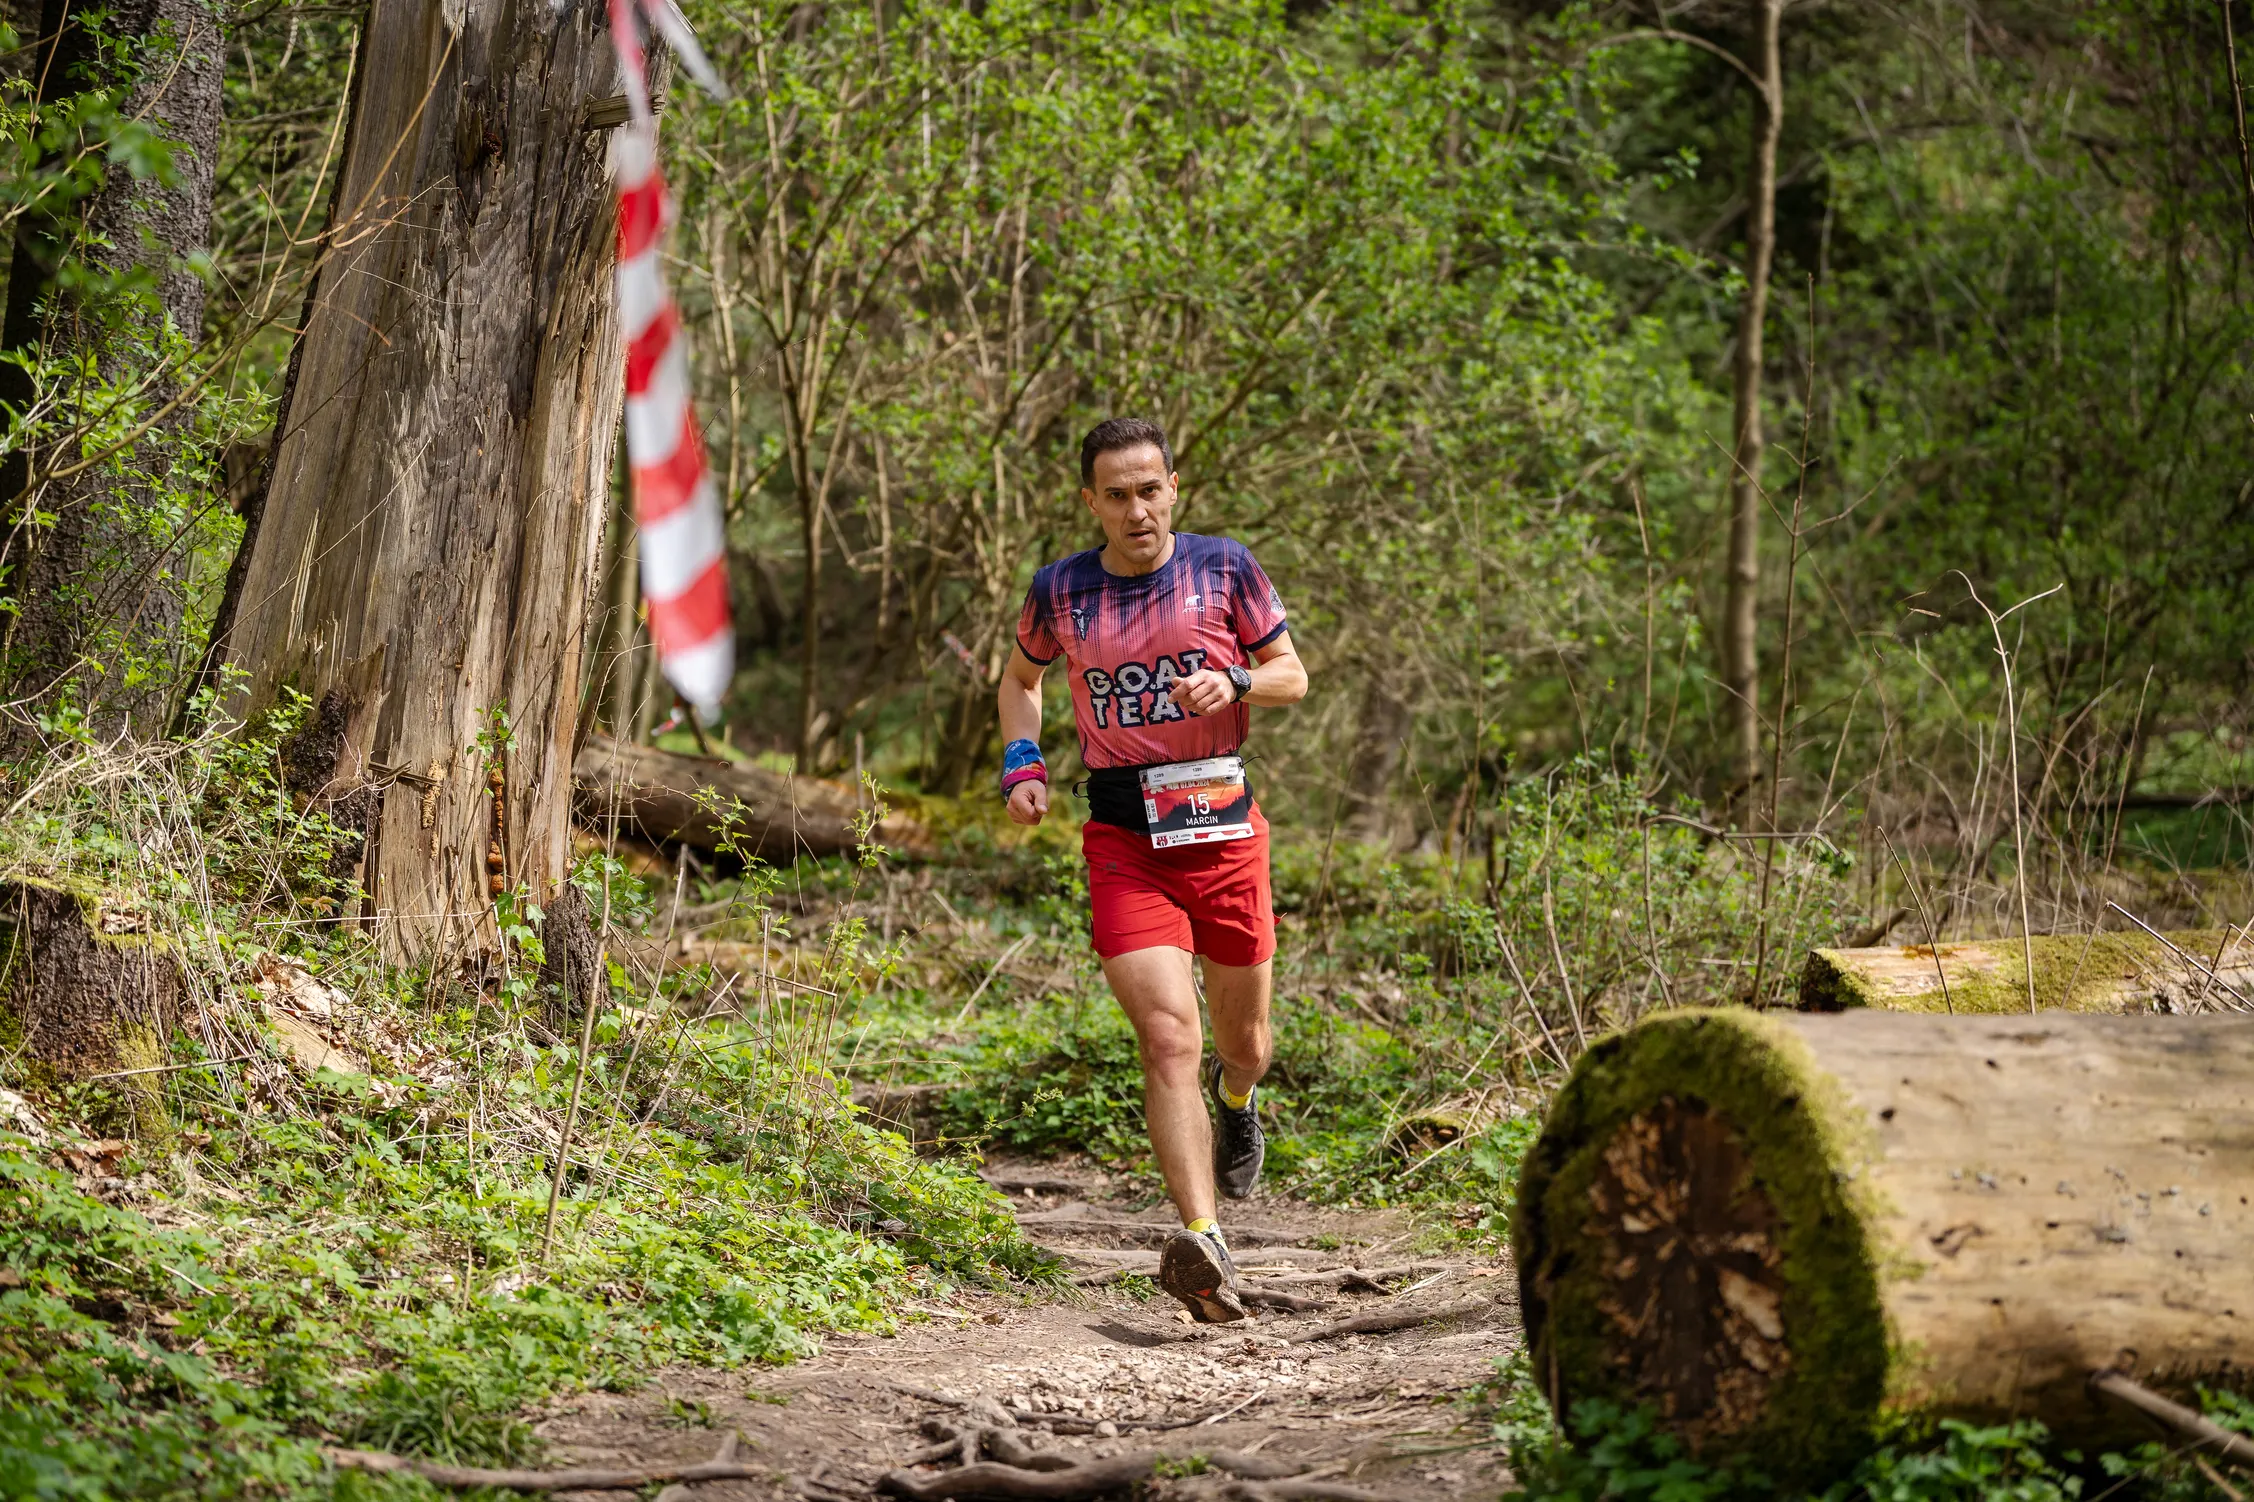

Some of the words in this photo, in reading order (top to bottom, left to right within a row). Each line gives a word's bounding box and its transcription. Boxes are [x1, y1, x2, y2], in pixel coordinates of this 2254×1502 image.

[1091, 691, 1196, 727] TEA
[1187, 793, 1210, 816] 15
[1185, 815, 1219, 827] MARCIN
